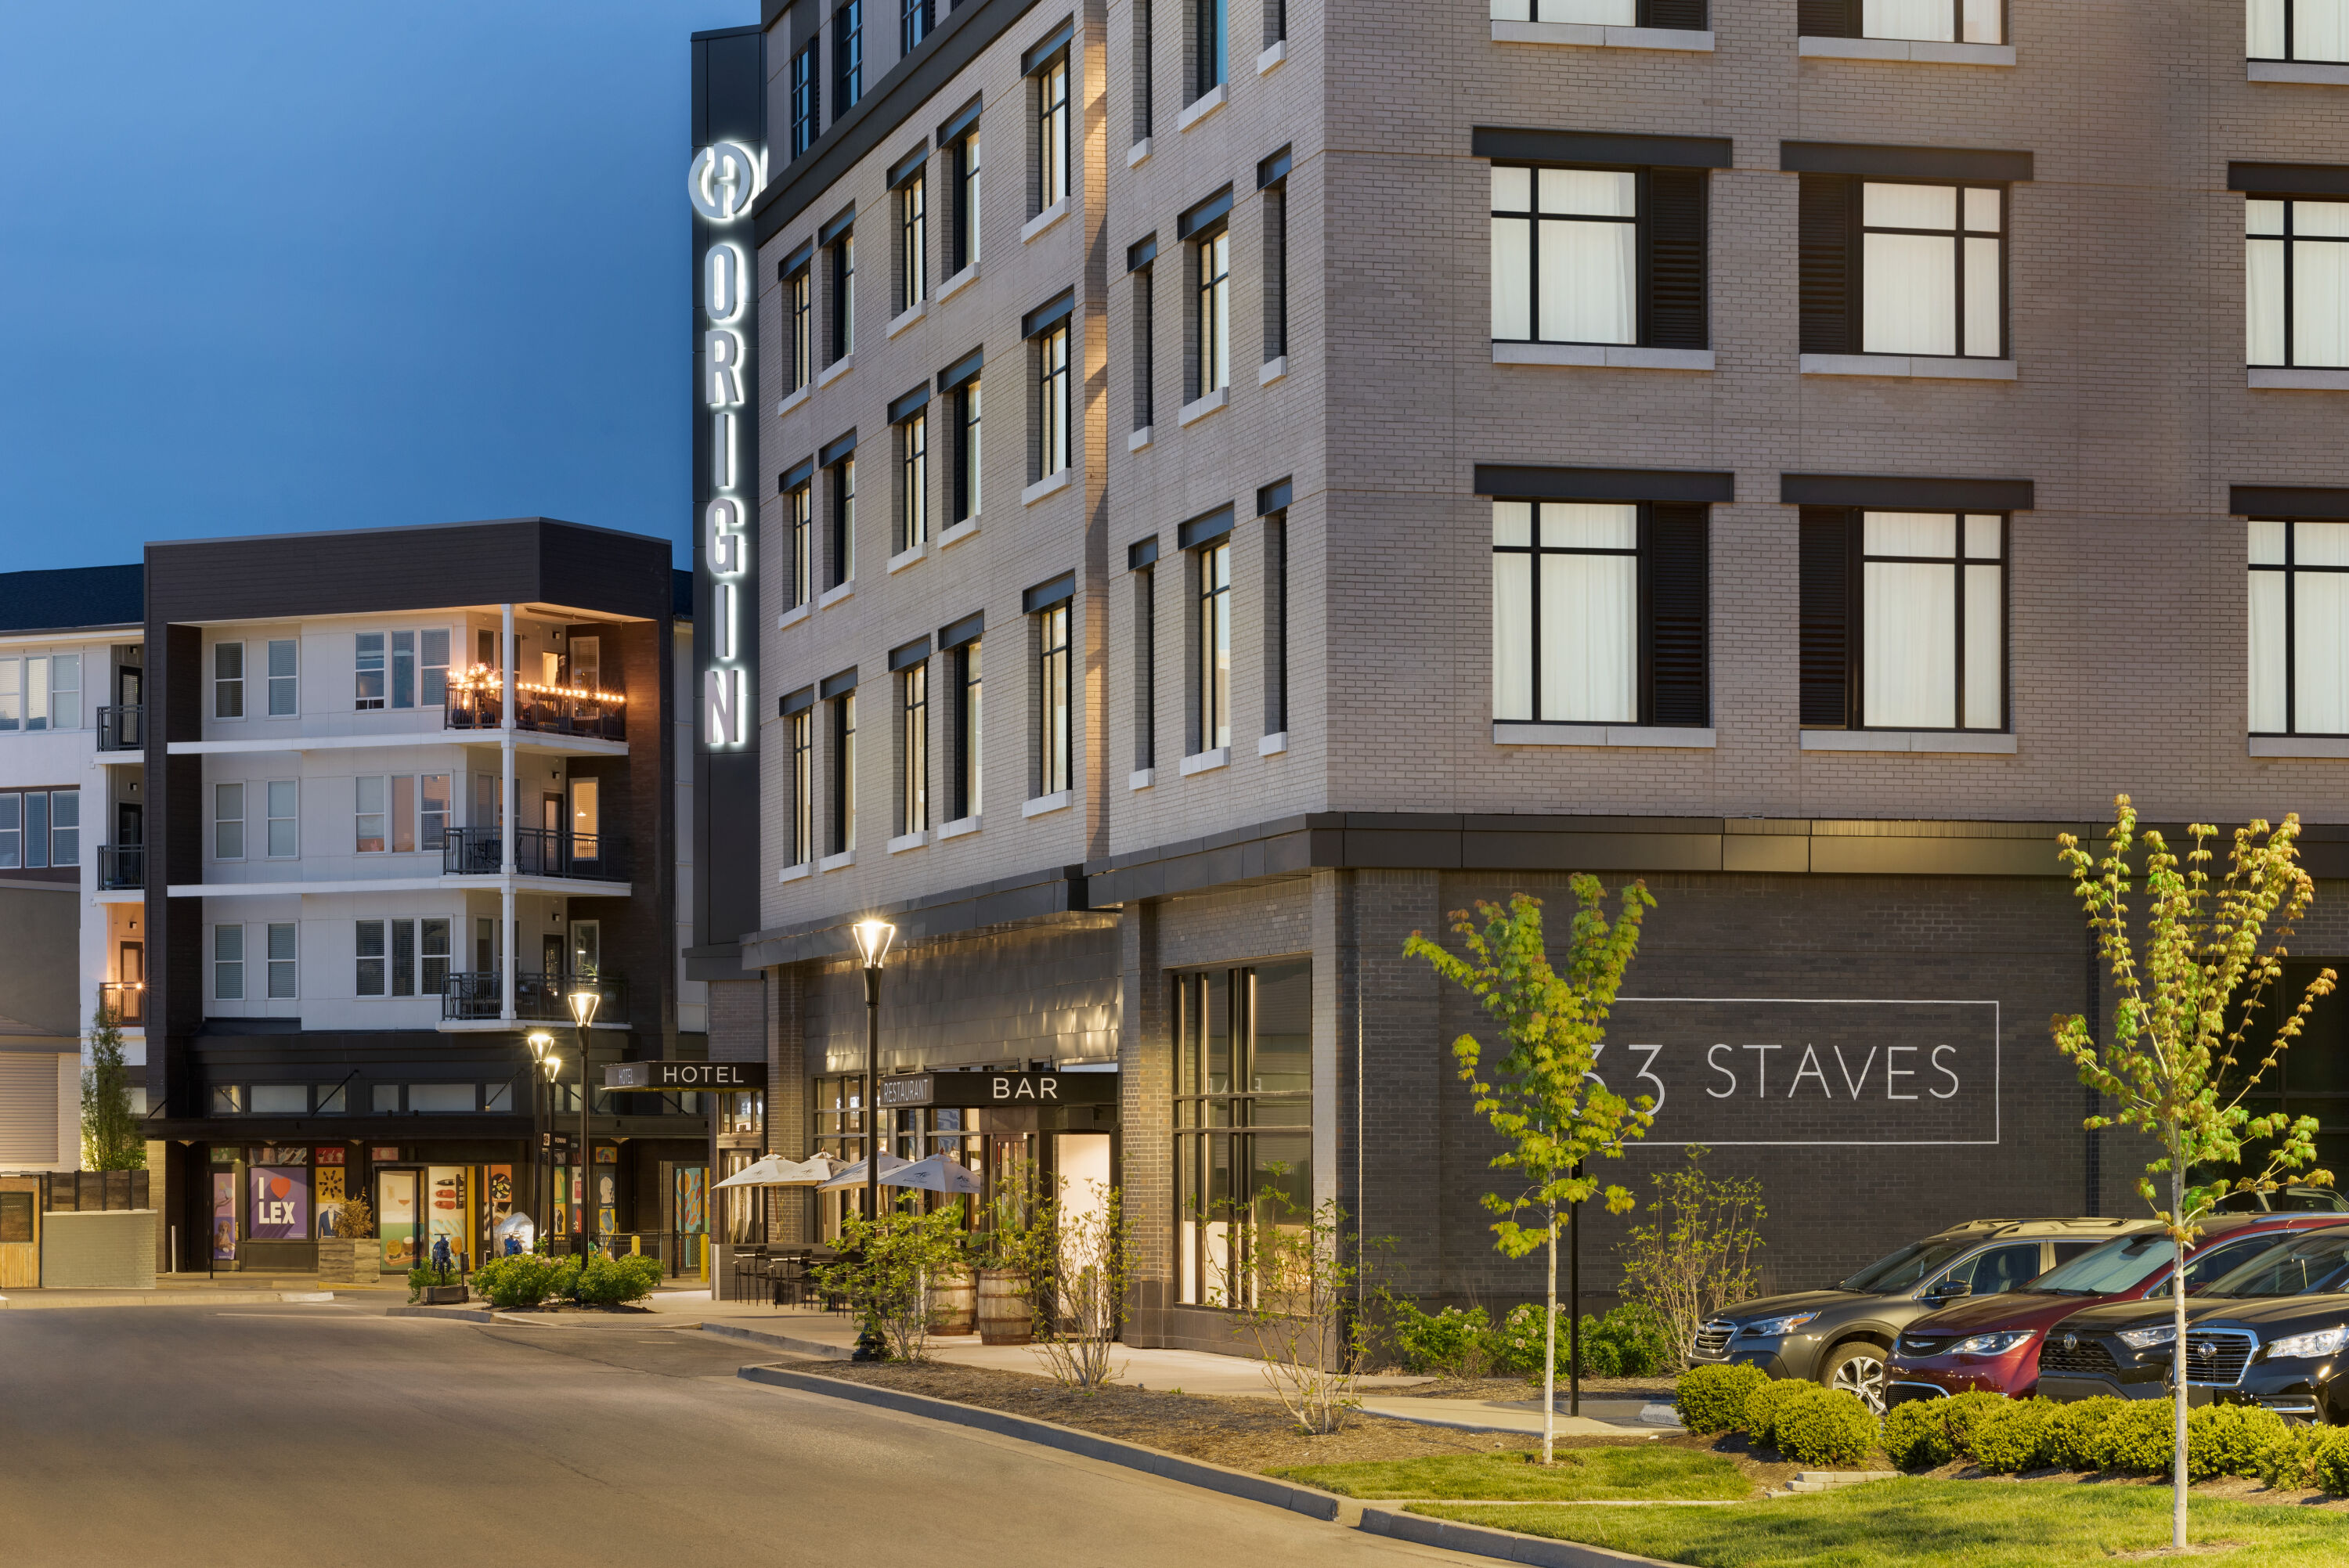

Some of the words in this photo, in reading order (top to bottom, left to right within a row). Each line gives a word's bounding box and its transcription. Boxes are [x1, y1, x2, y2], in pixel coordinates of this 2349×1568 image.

[705, 244, 742, 744] ORIGIN
[619, 1068, 633, 1084] HOTEL
[663, 1066, 744, 1083] HOTEL
[1706, 1044, 1958, 1100] STAVES
[884, 1079, 928, 1103] RESTAURANT
[993, 1077, 1057, 1099] BAR
[258, 1177, 265, 1199] I
[258, 1202, 295, 1224] LEX
